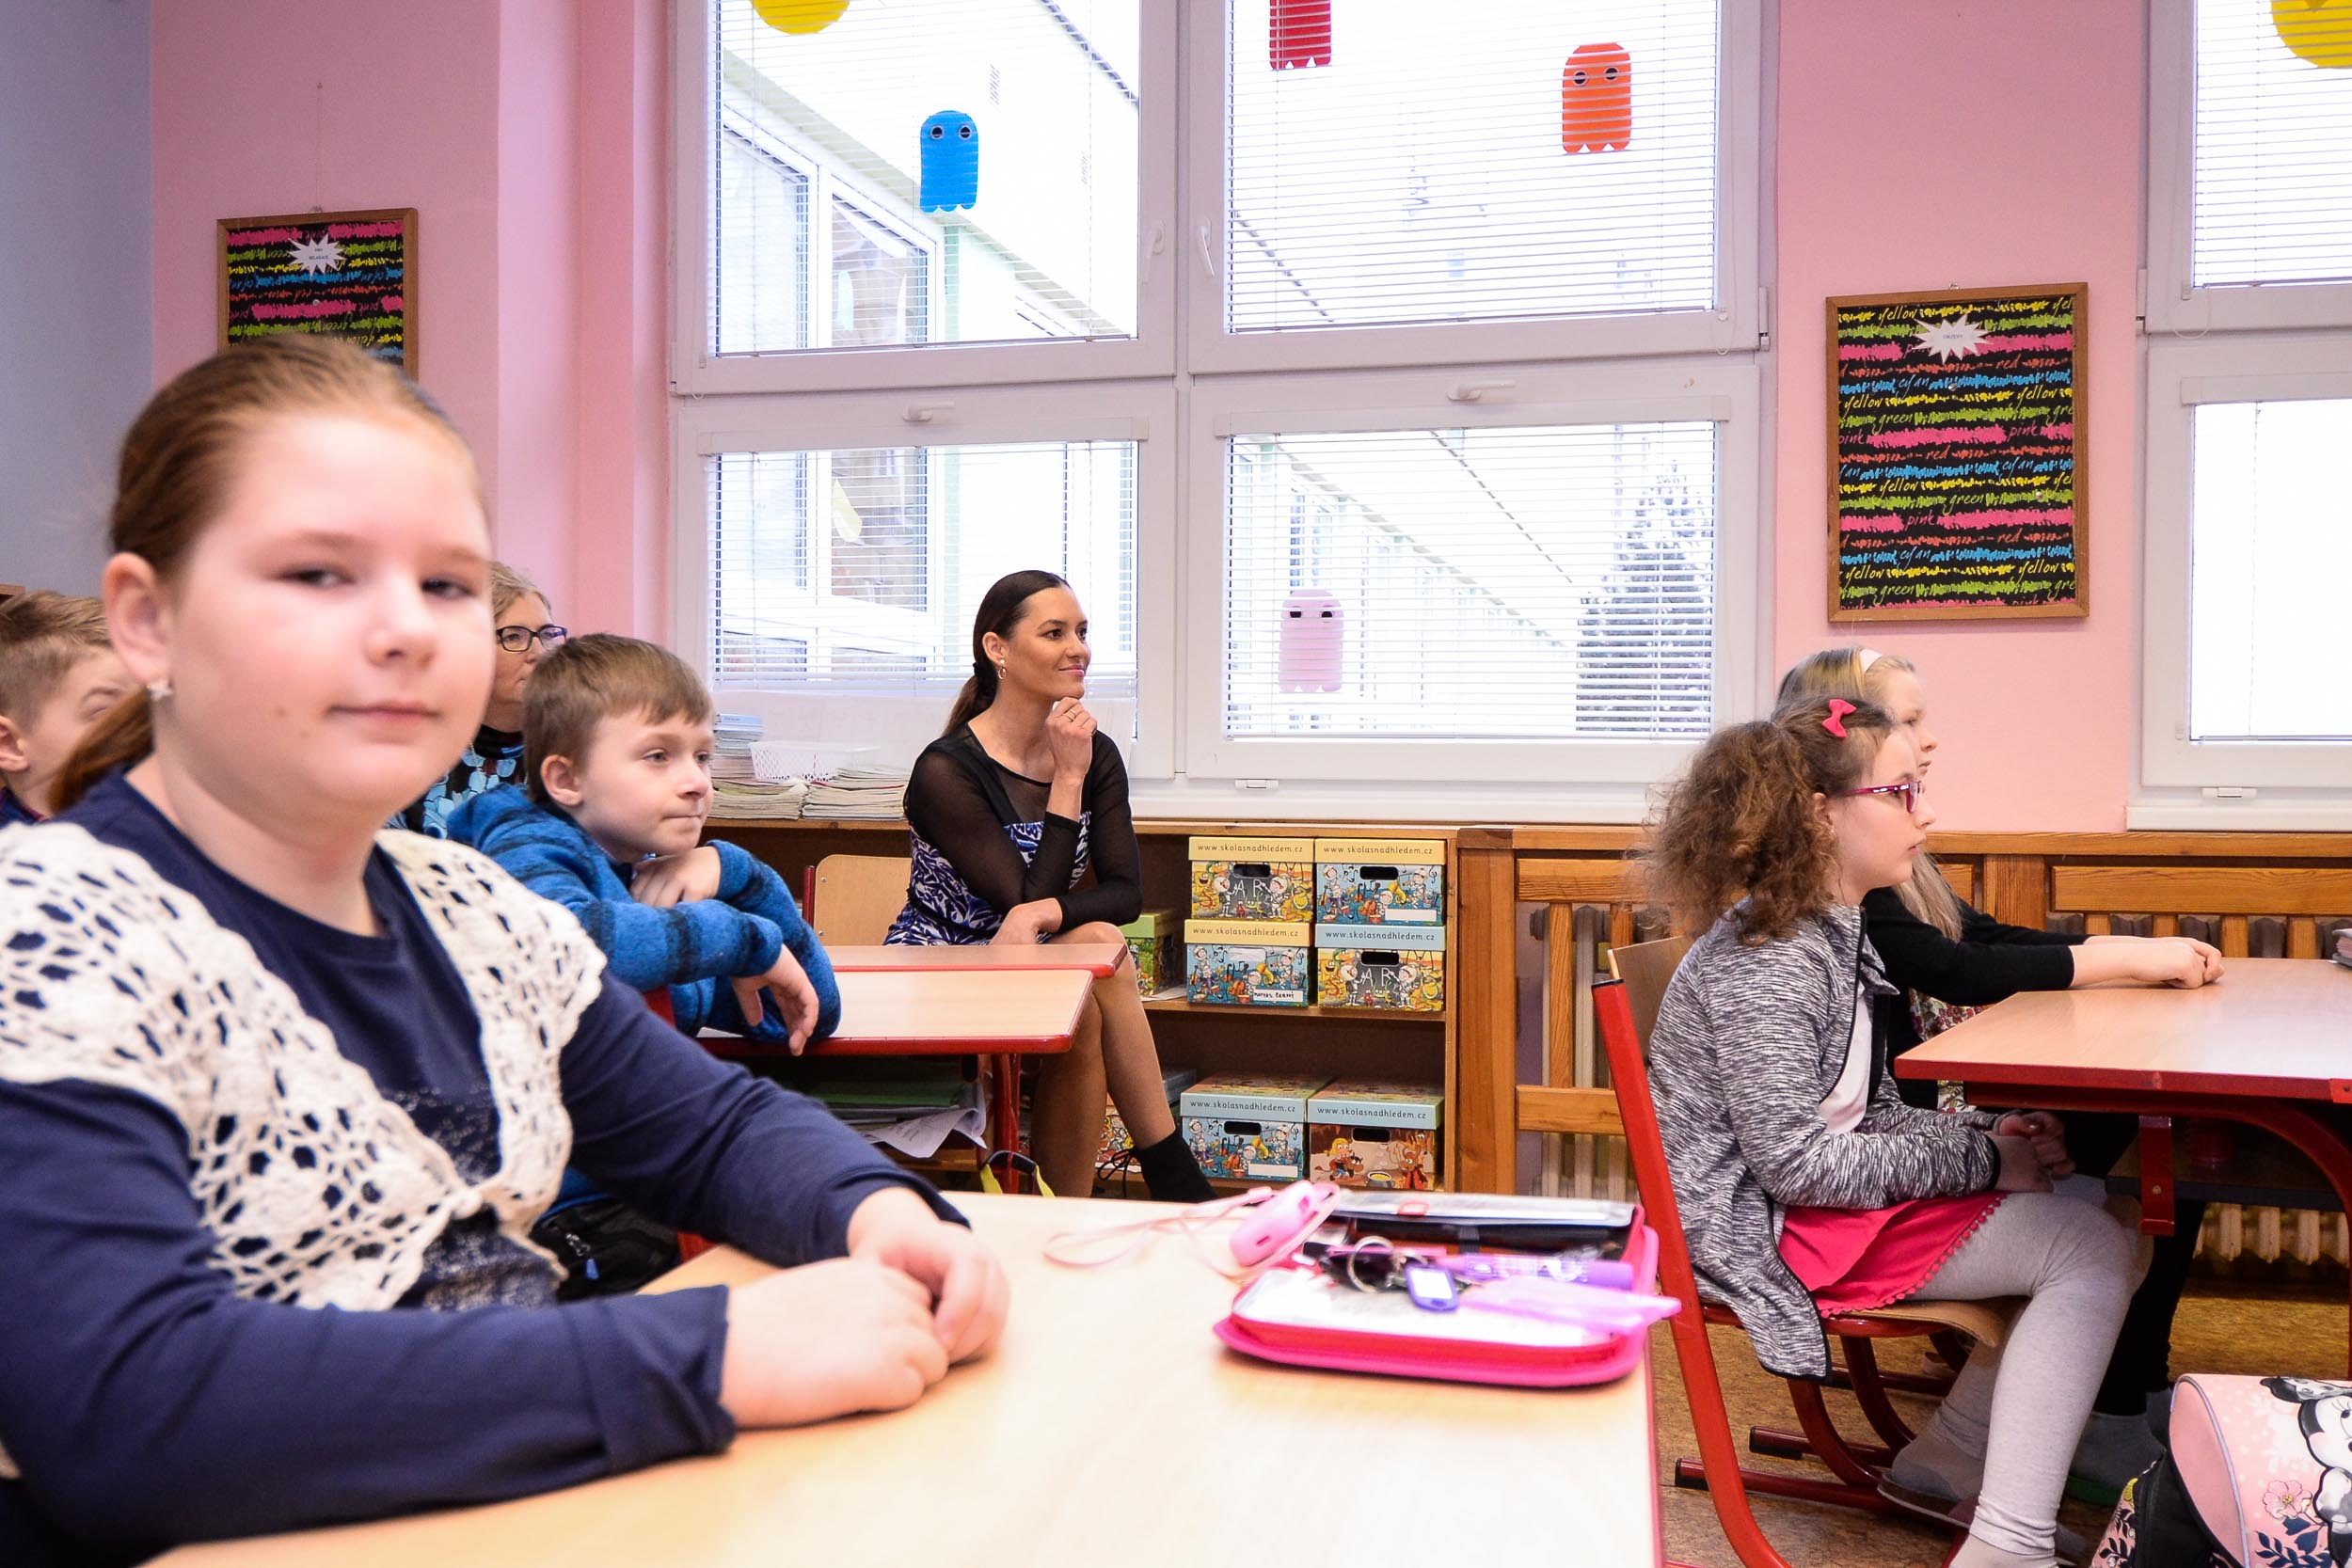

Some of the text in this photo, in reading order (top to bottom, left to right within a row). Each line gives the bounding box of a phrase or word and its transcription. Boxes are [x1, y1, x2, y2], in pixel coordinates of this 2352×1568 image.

[1878, 296, 2074, 326] yellow yel
[1995, 354, 2022, 369] red
[1897, 374, 1930, 399] cyan
[1844, 385, 2058, 418] yellow yellow
[1872, 414, 1914, 435] green
[2007, 420, 2039, 442] pink
[1926, 445, 1951, 459] red
[2000, 456, 2034, 481] cyan
[1880, 472, 2074, 498] yellow yel
[1943, 494, 1984, 515] green
[1904, 509, 1935, 531] pink
[1996, 528, 2023, 543] red
[1897, 546, 1931, 570] cyan
[1846, 559, 2059, 589] yellow yellow
[1873, 585, 1915, 606] green
[1197, 844, 1303, 853] www.skolasnadhledem.cz
[1193, 927, 1298, 937] www.skolasnadhledem.cz
[1326, 930, 1435, 941] www.skolasnadhledem.cz
[1190, 1101, 1295, 1113] www.skolasnadhledem.cz
[1317, 1107, 1426, 1119] www.skolasnadhledem.cz
